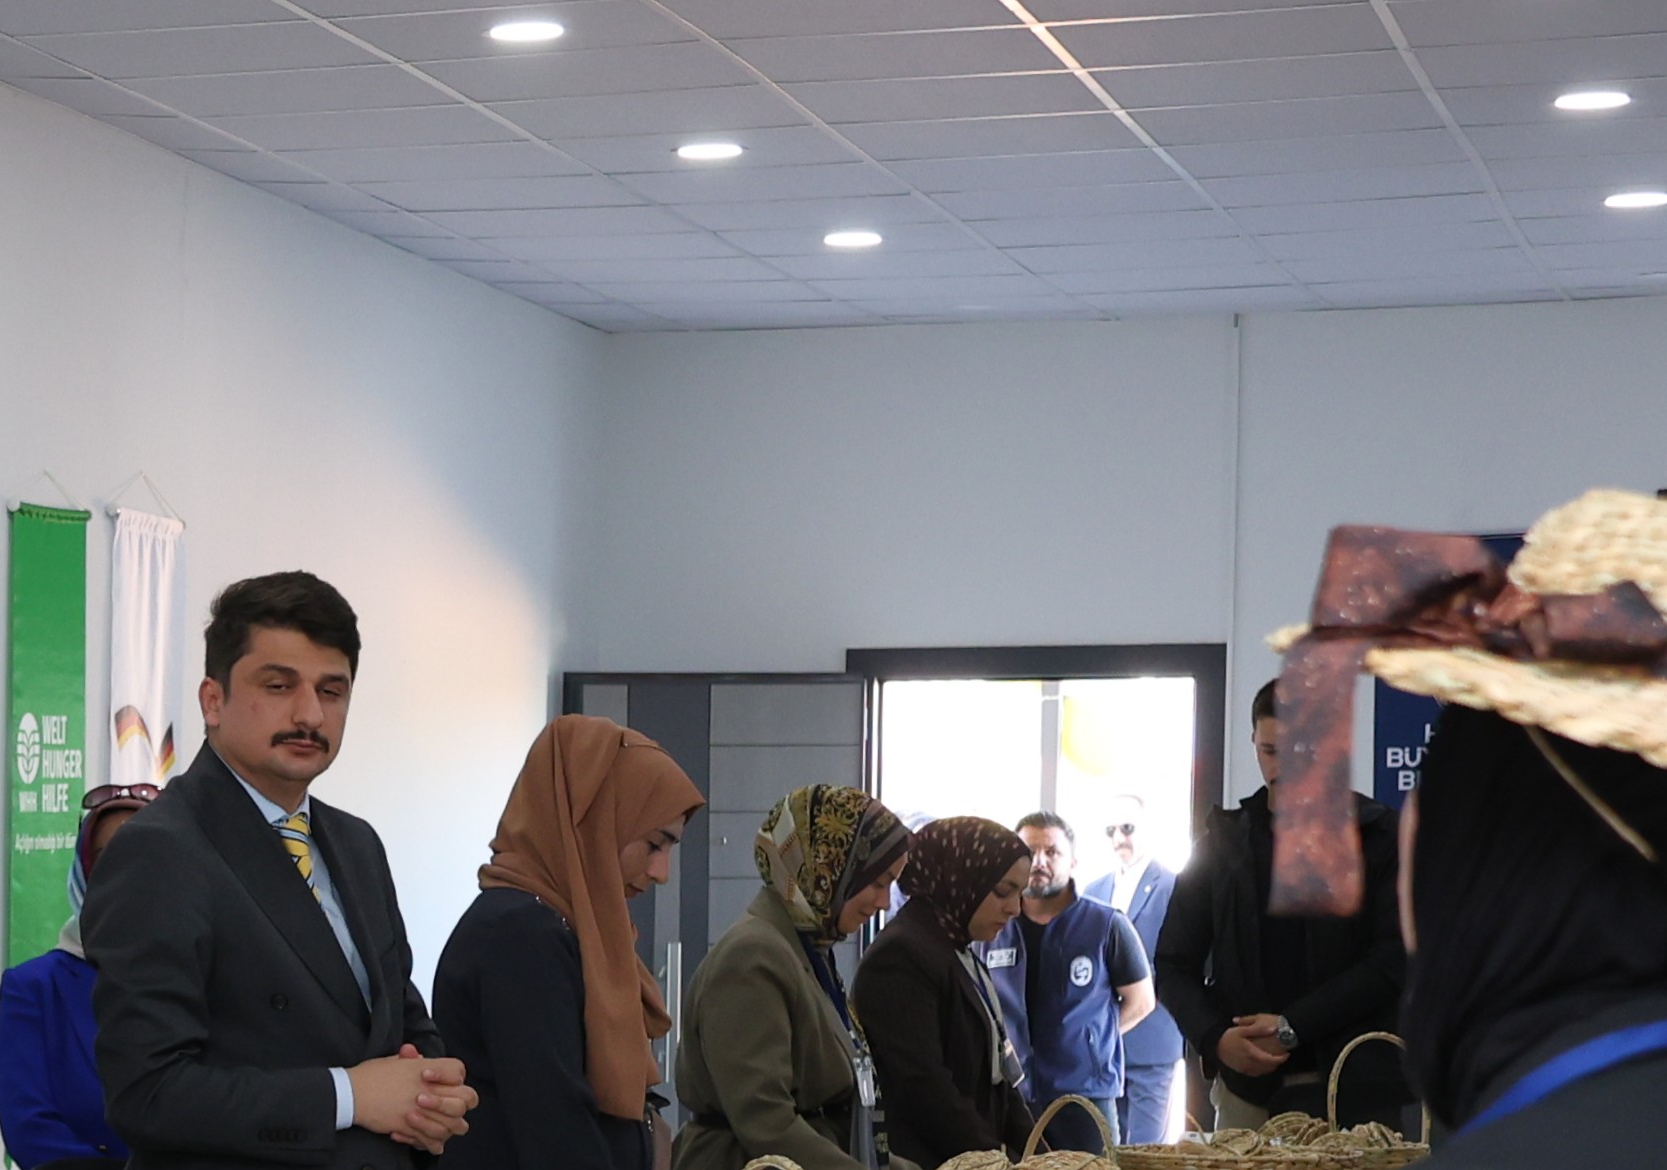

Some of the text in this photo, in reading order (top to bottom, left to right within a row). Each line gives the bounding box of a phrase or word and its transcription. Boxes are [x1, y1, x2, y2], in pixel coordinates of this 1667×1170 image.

[42, 715, 67, 744] WELT
[42, 749, 82, 778] HUNGER
[42, 783, 69, 813] HILFE
